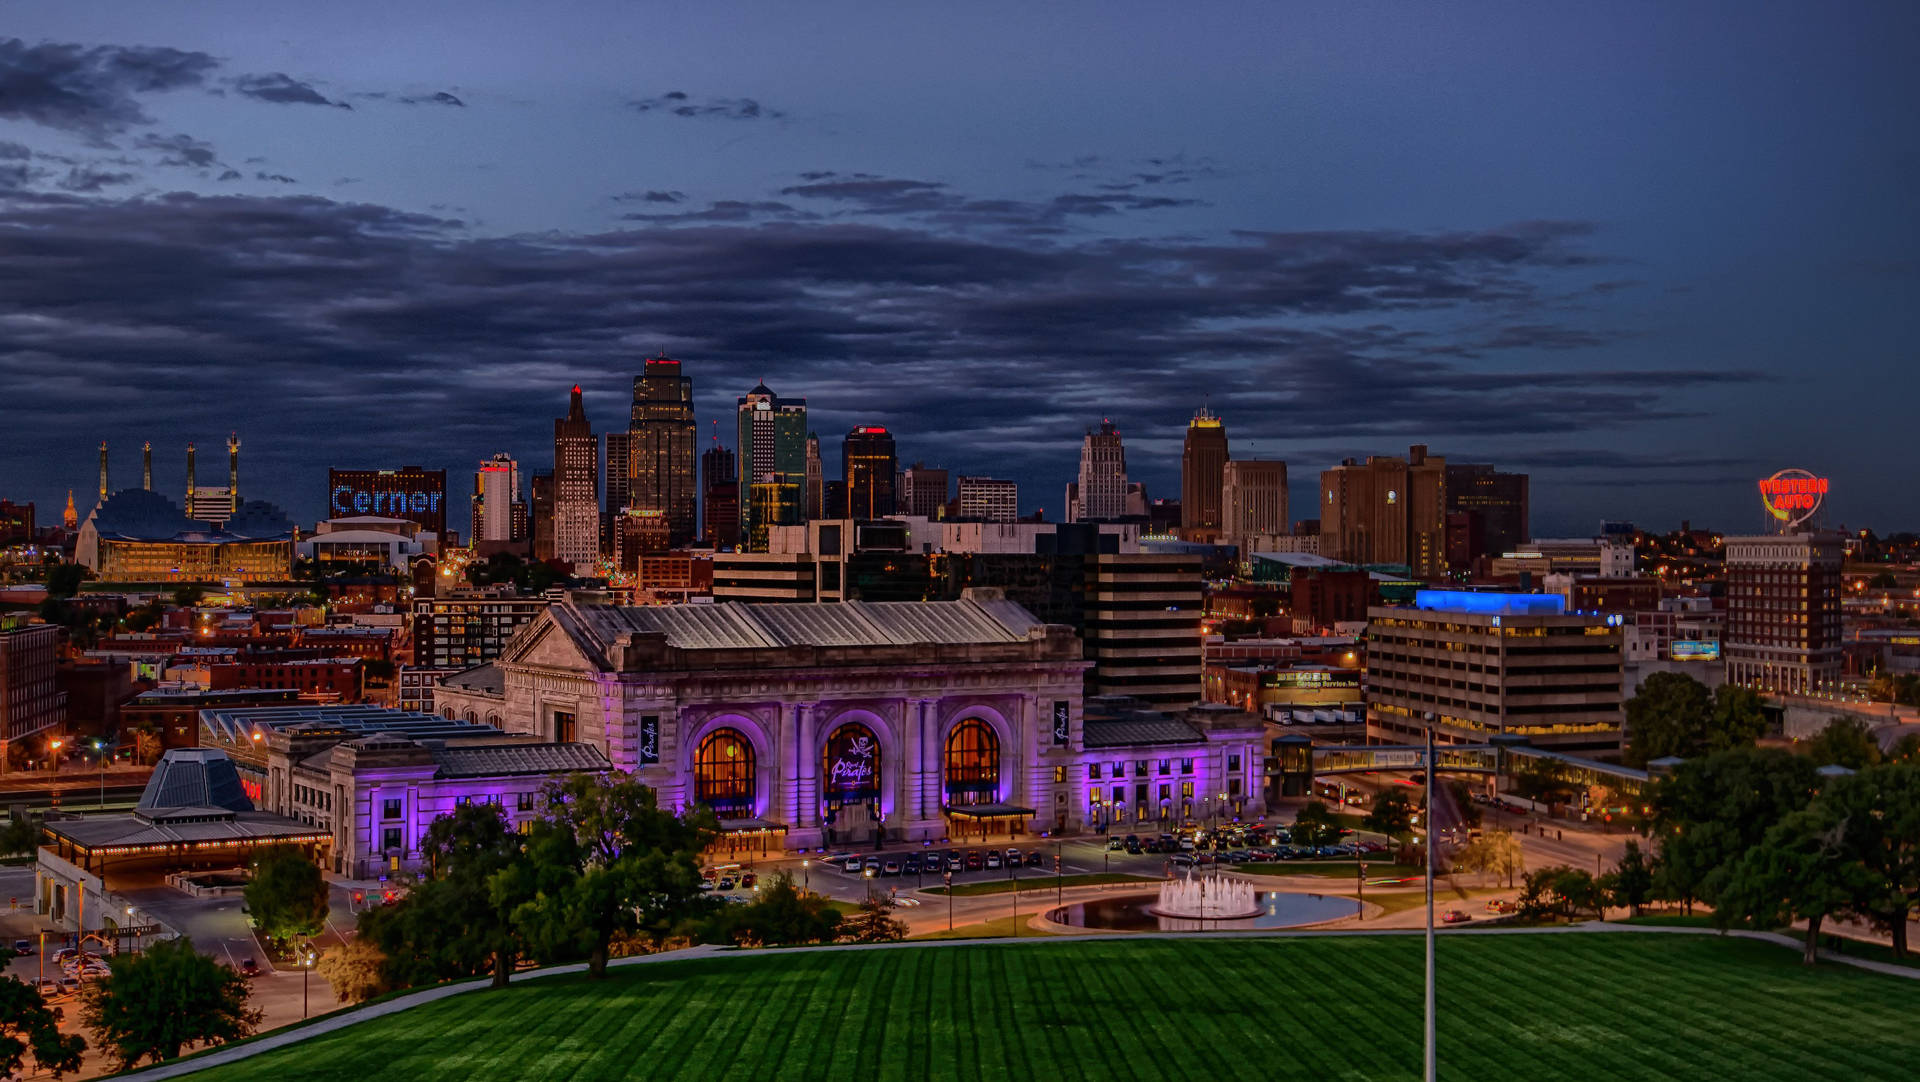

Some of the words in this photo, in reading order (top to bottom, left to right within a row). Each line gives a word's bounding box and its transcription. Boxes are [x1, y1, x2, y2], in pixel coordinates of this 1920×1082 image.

[332, 485, 442, 512] Cerner
[1759, 478, 1828, 495] WESTERN
[1774, 494, 1814, 509] AUTO
[1055, 707, 1069, 740] Pirates
[642, 722, 659, 758] Pirates
[831, 757, 872, 784] Pirates
